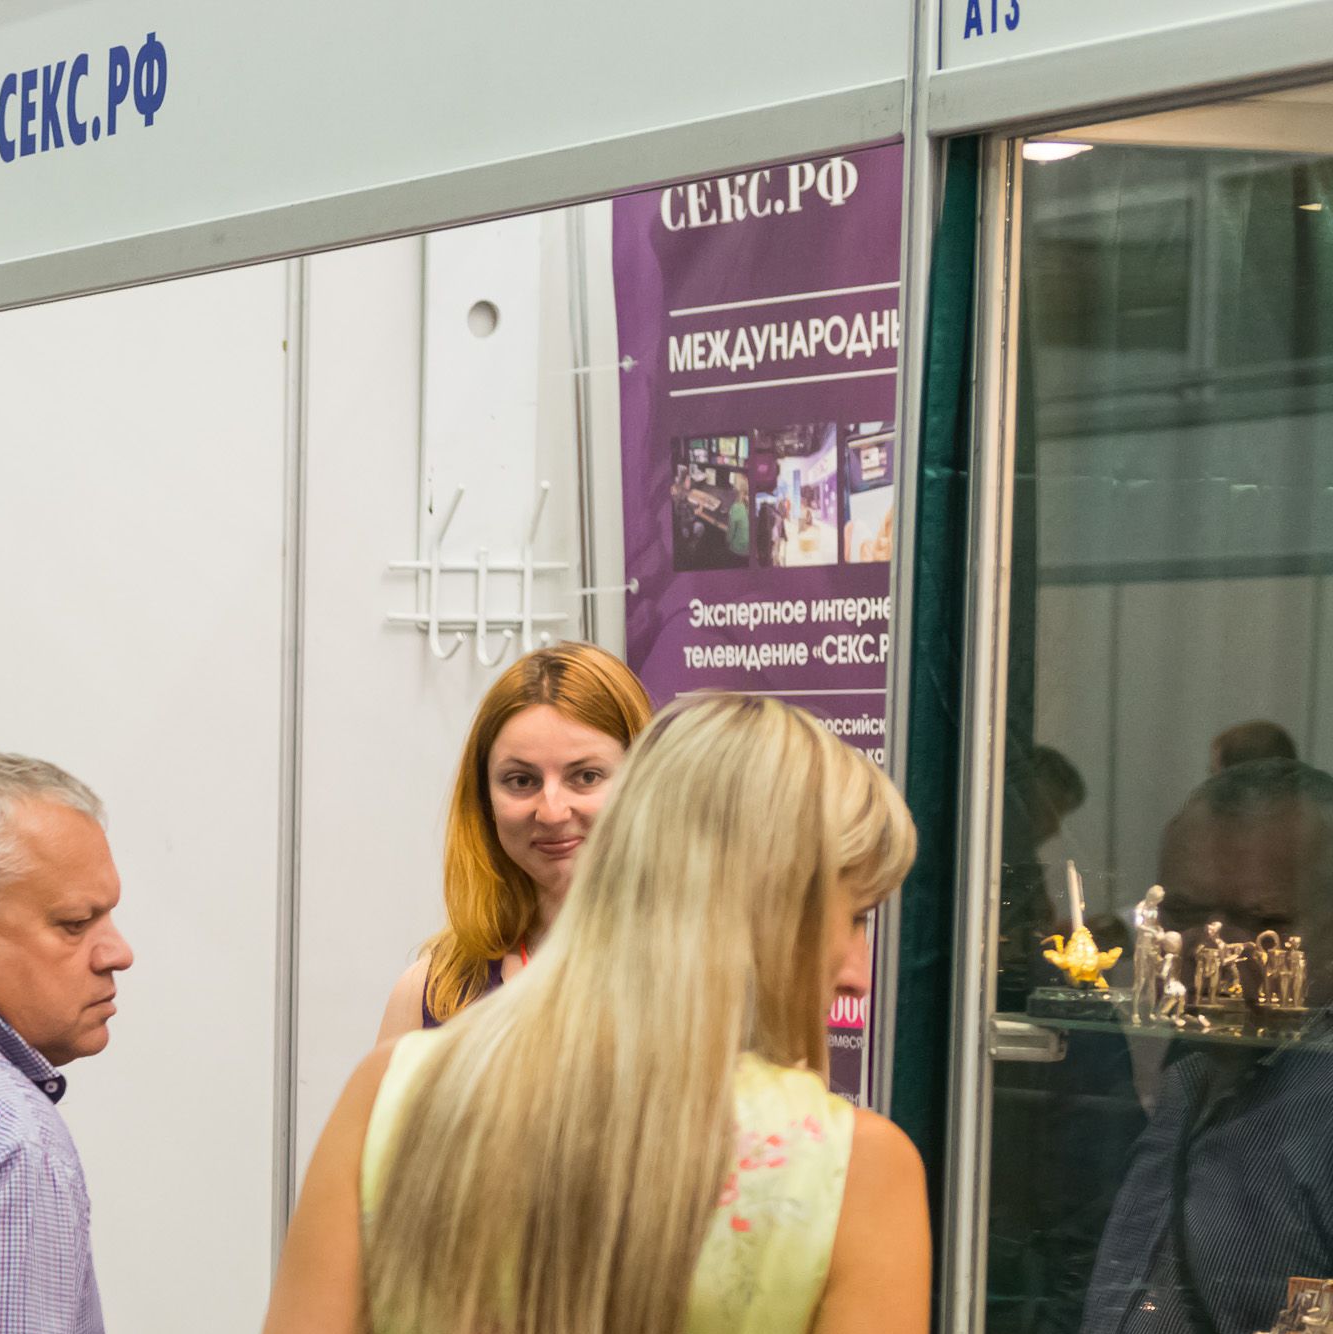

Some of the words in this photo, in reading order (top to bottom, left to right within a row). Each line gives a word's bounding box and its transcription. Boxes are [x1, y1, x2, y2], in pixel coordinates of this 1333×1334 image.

[660, 156, 859, 232] СЕКС.РФ
[689, 598, 808, 632] Экспертное
[684, 642, 808, 671] телевидение
